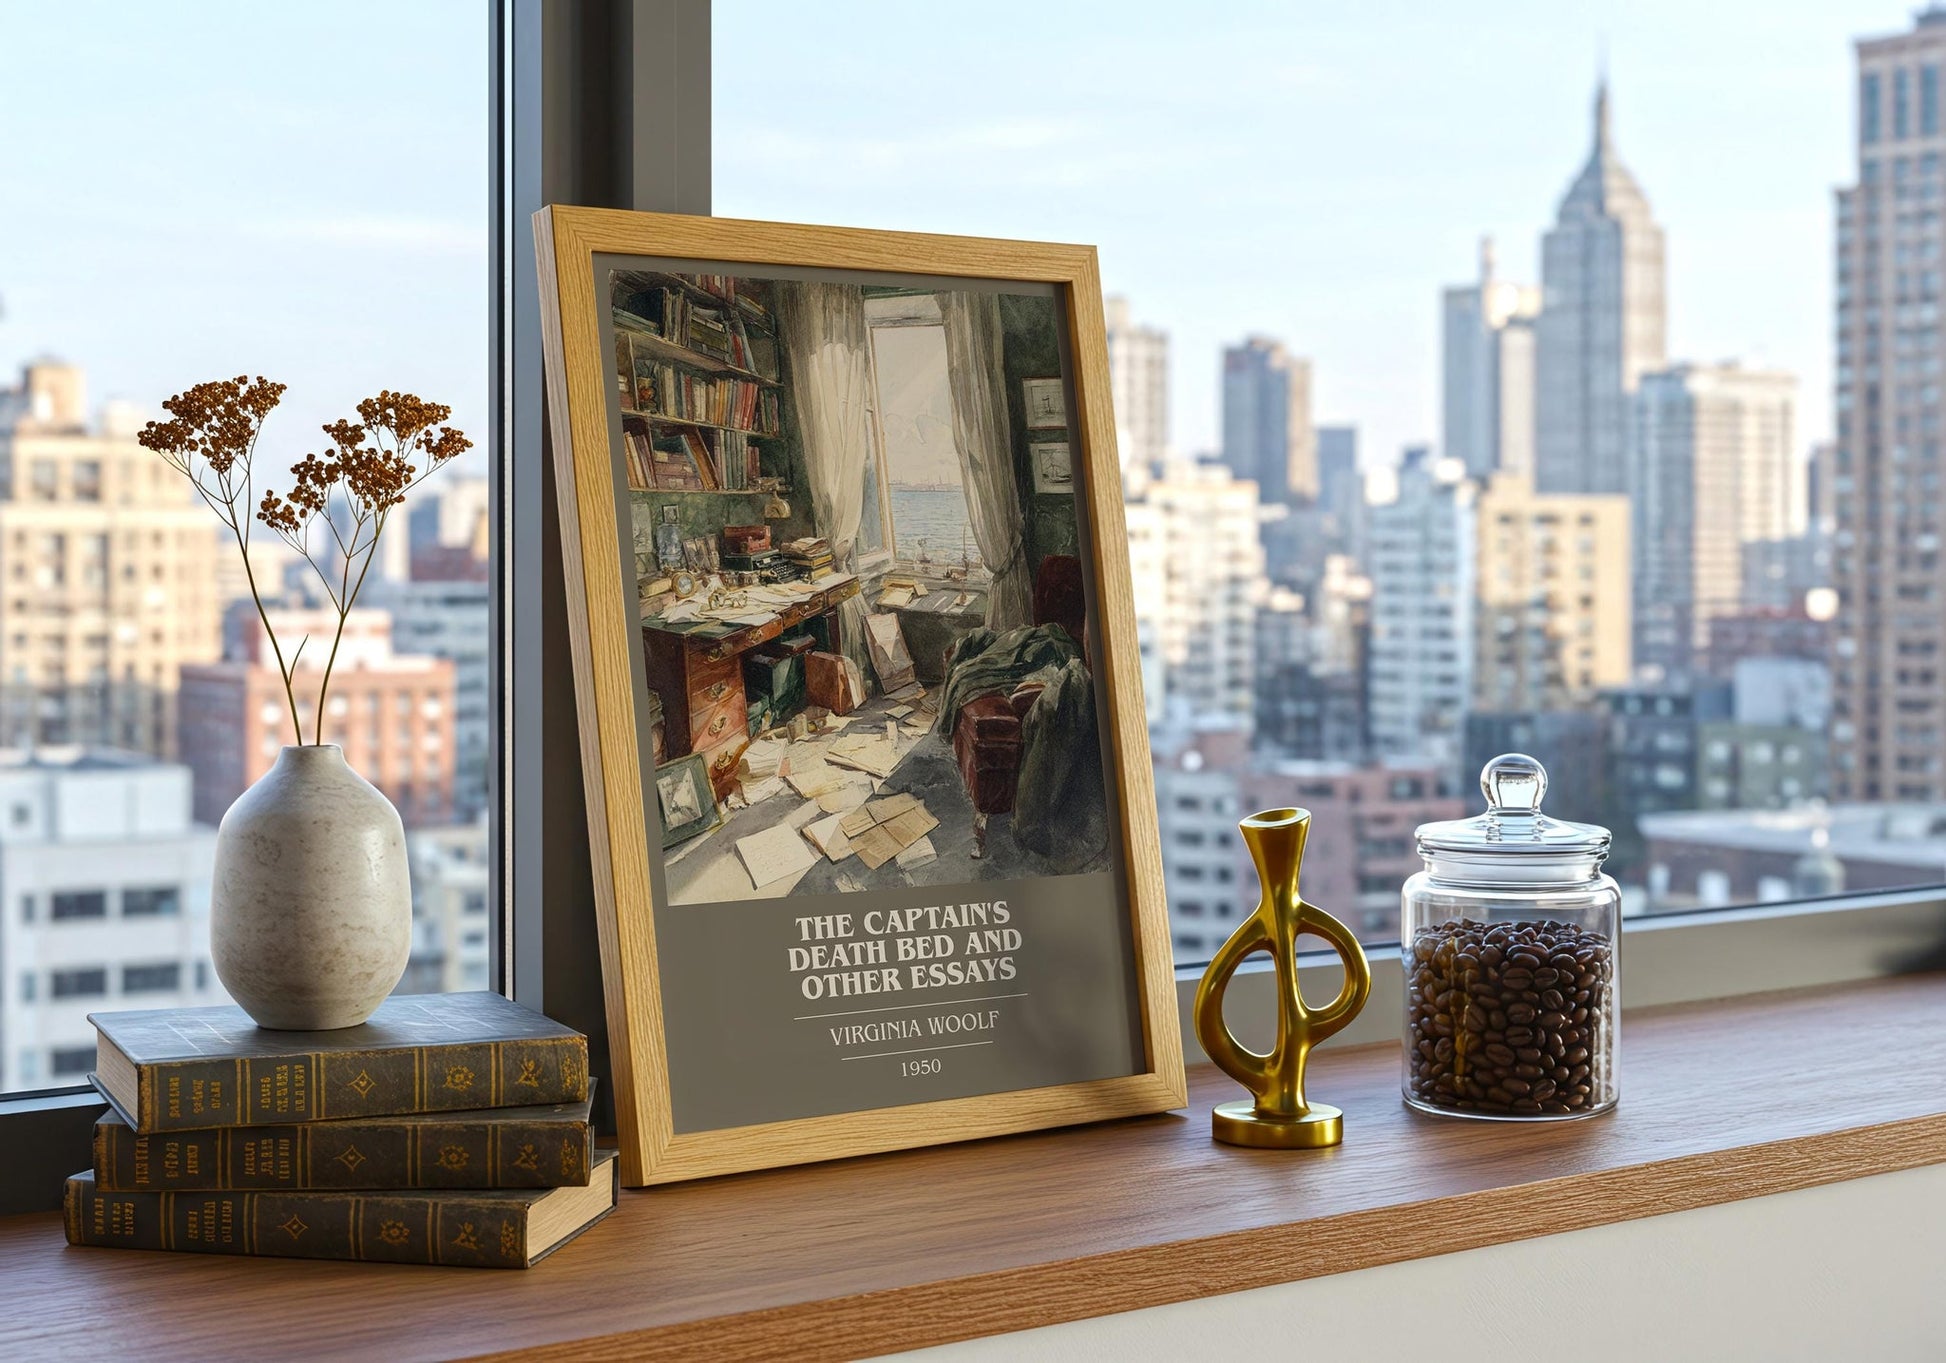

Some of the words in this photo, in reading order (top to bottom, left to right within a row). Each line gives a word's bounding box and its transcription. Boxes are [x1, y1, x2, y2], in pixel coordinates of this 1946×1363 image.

[795, 914, 855, 941] THE
[864, 901, 1010, 934] CAPTAIN'S
[788, 941, 887, 971] DEATH
[896, 935, 954, 962] BED
[965, 929, 1022, 955] AND
[801, 968, 903, 1000] OTHER
[910, 957, 1017, 989] ESSAYS
[830, 1019, 922, 1045] VIRGINIA
[928, 1011, 1000, 1035] WOOLF
[901, 1059, 942, 1077] 1950
